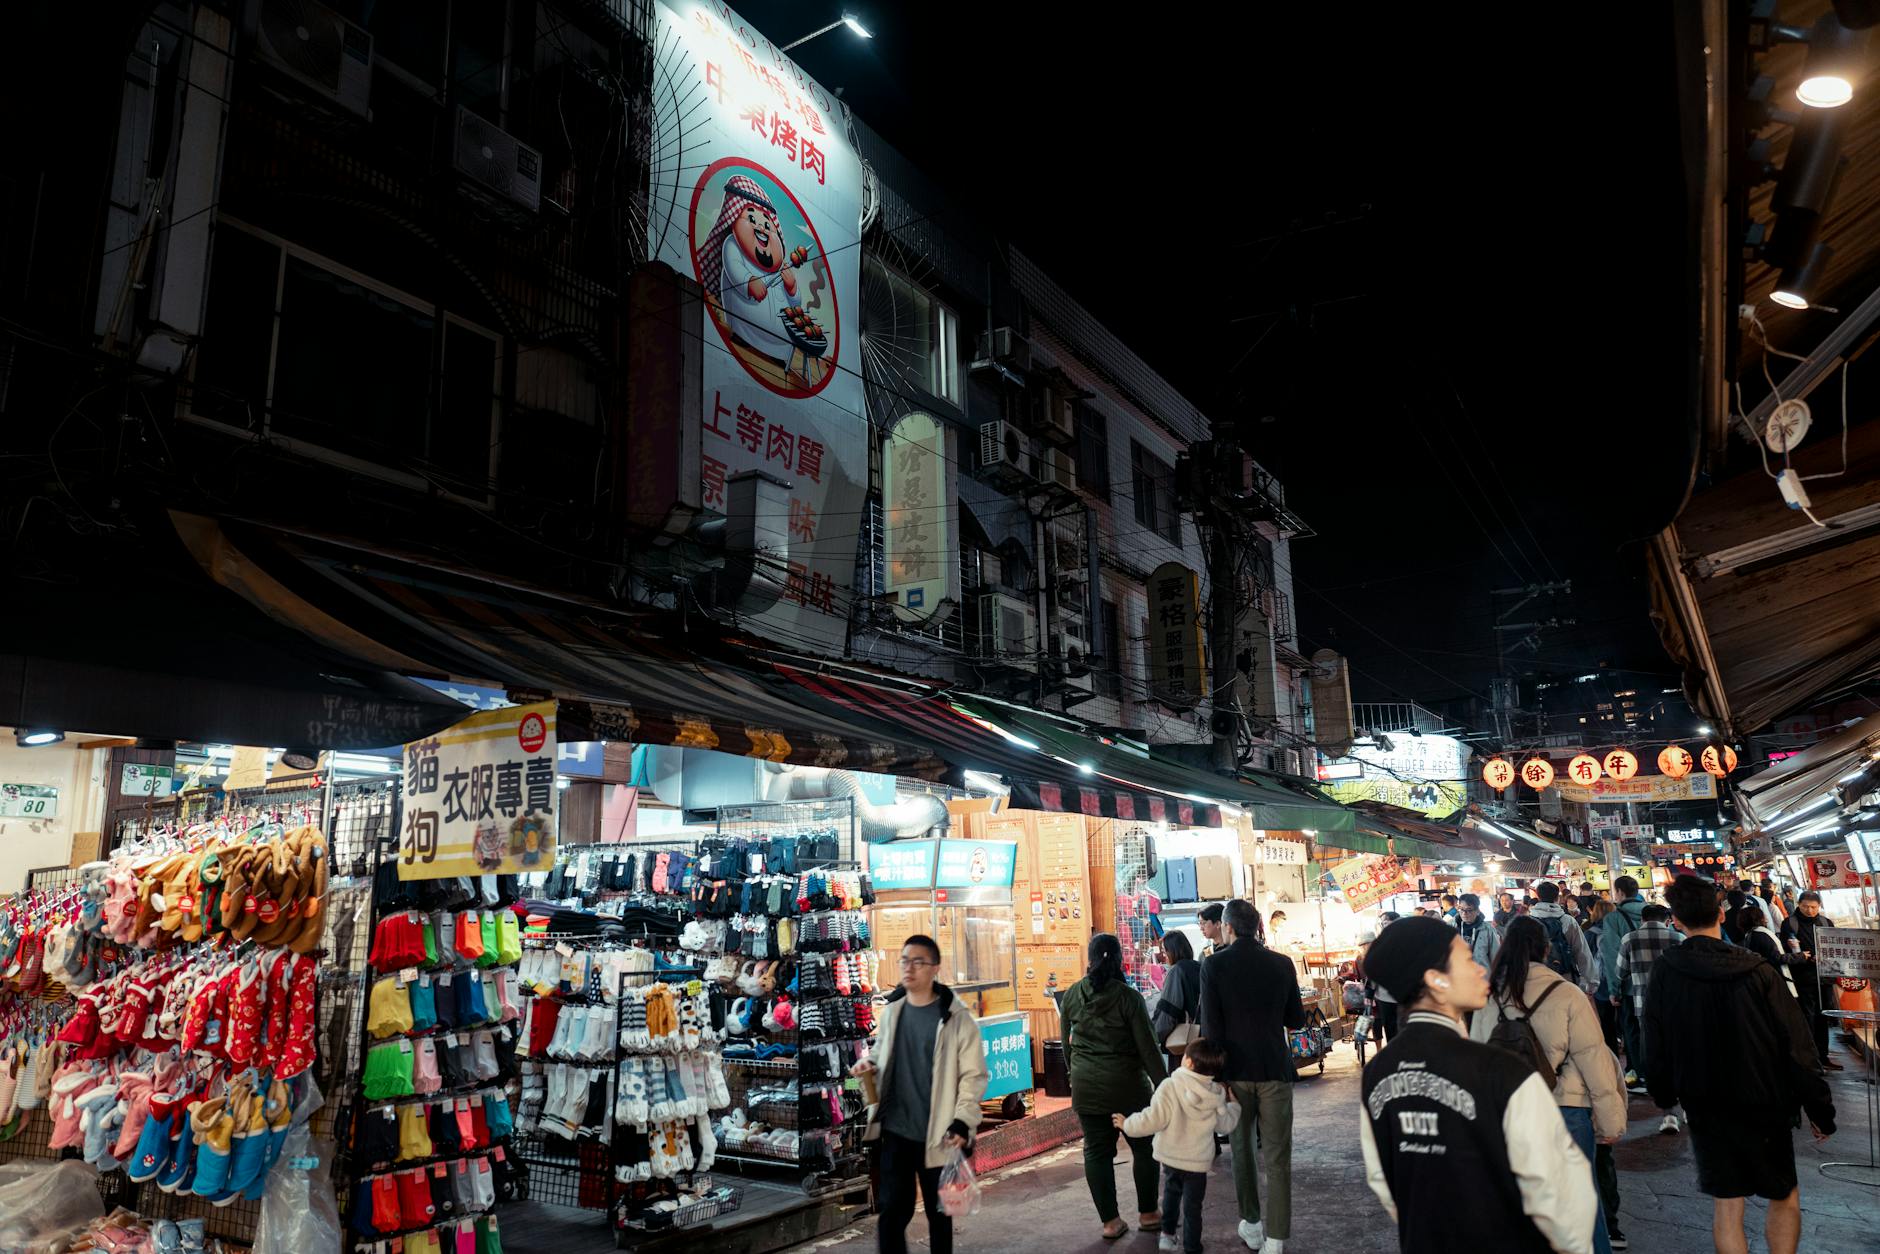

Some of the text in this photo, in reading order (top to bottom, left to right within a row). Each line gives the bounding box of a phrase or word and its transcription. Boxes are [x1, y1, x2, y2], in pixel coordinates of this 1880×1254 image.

[703, 390, 825, 484] 上等肉質
[1382, 757, 1425, 772] GENDER
[1526, 764, 1547, 783] 餘
[1576, 761, 1594, 780] 有
[1609, 755, 1629, 776] 年
[144, 779, 162, 792] 82
[442, 756, 555, 823] 衣服專賣
[24, 800, 45, 814] 80
[1600, 867, 1647, 881] 百香
